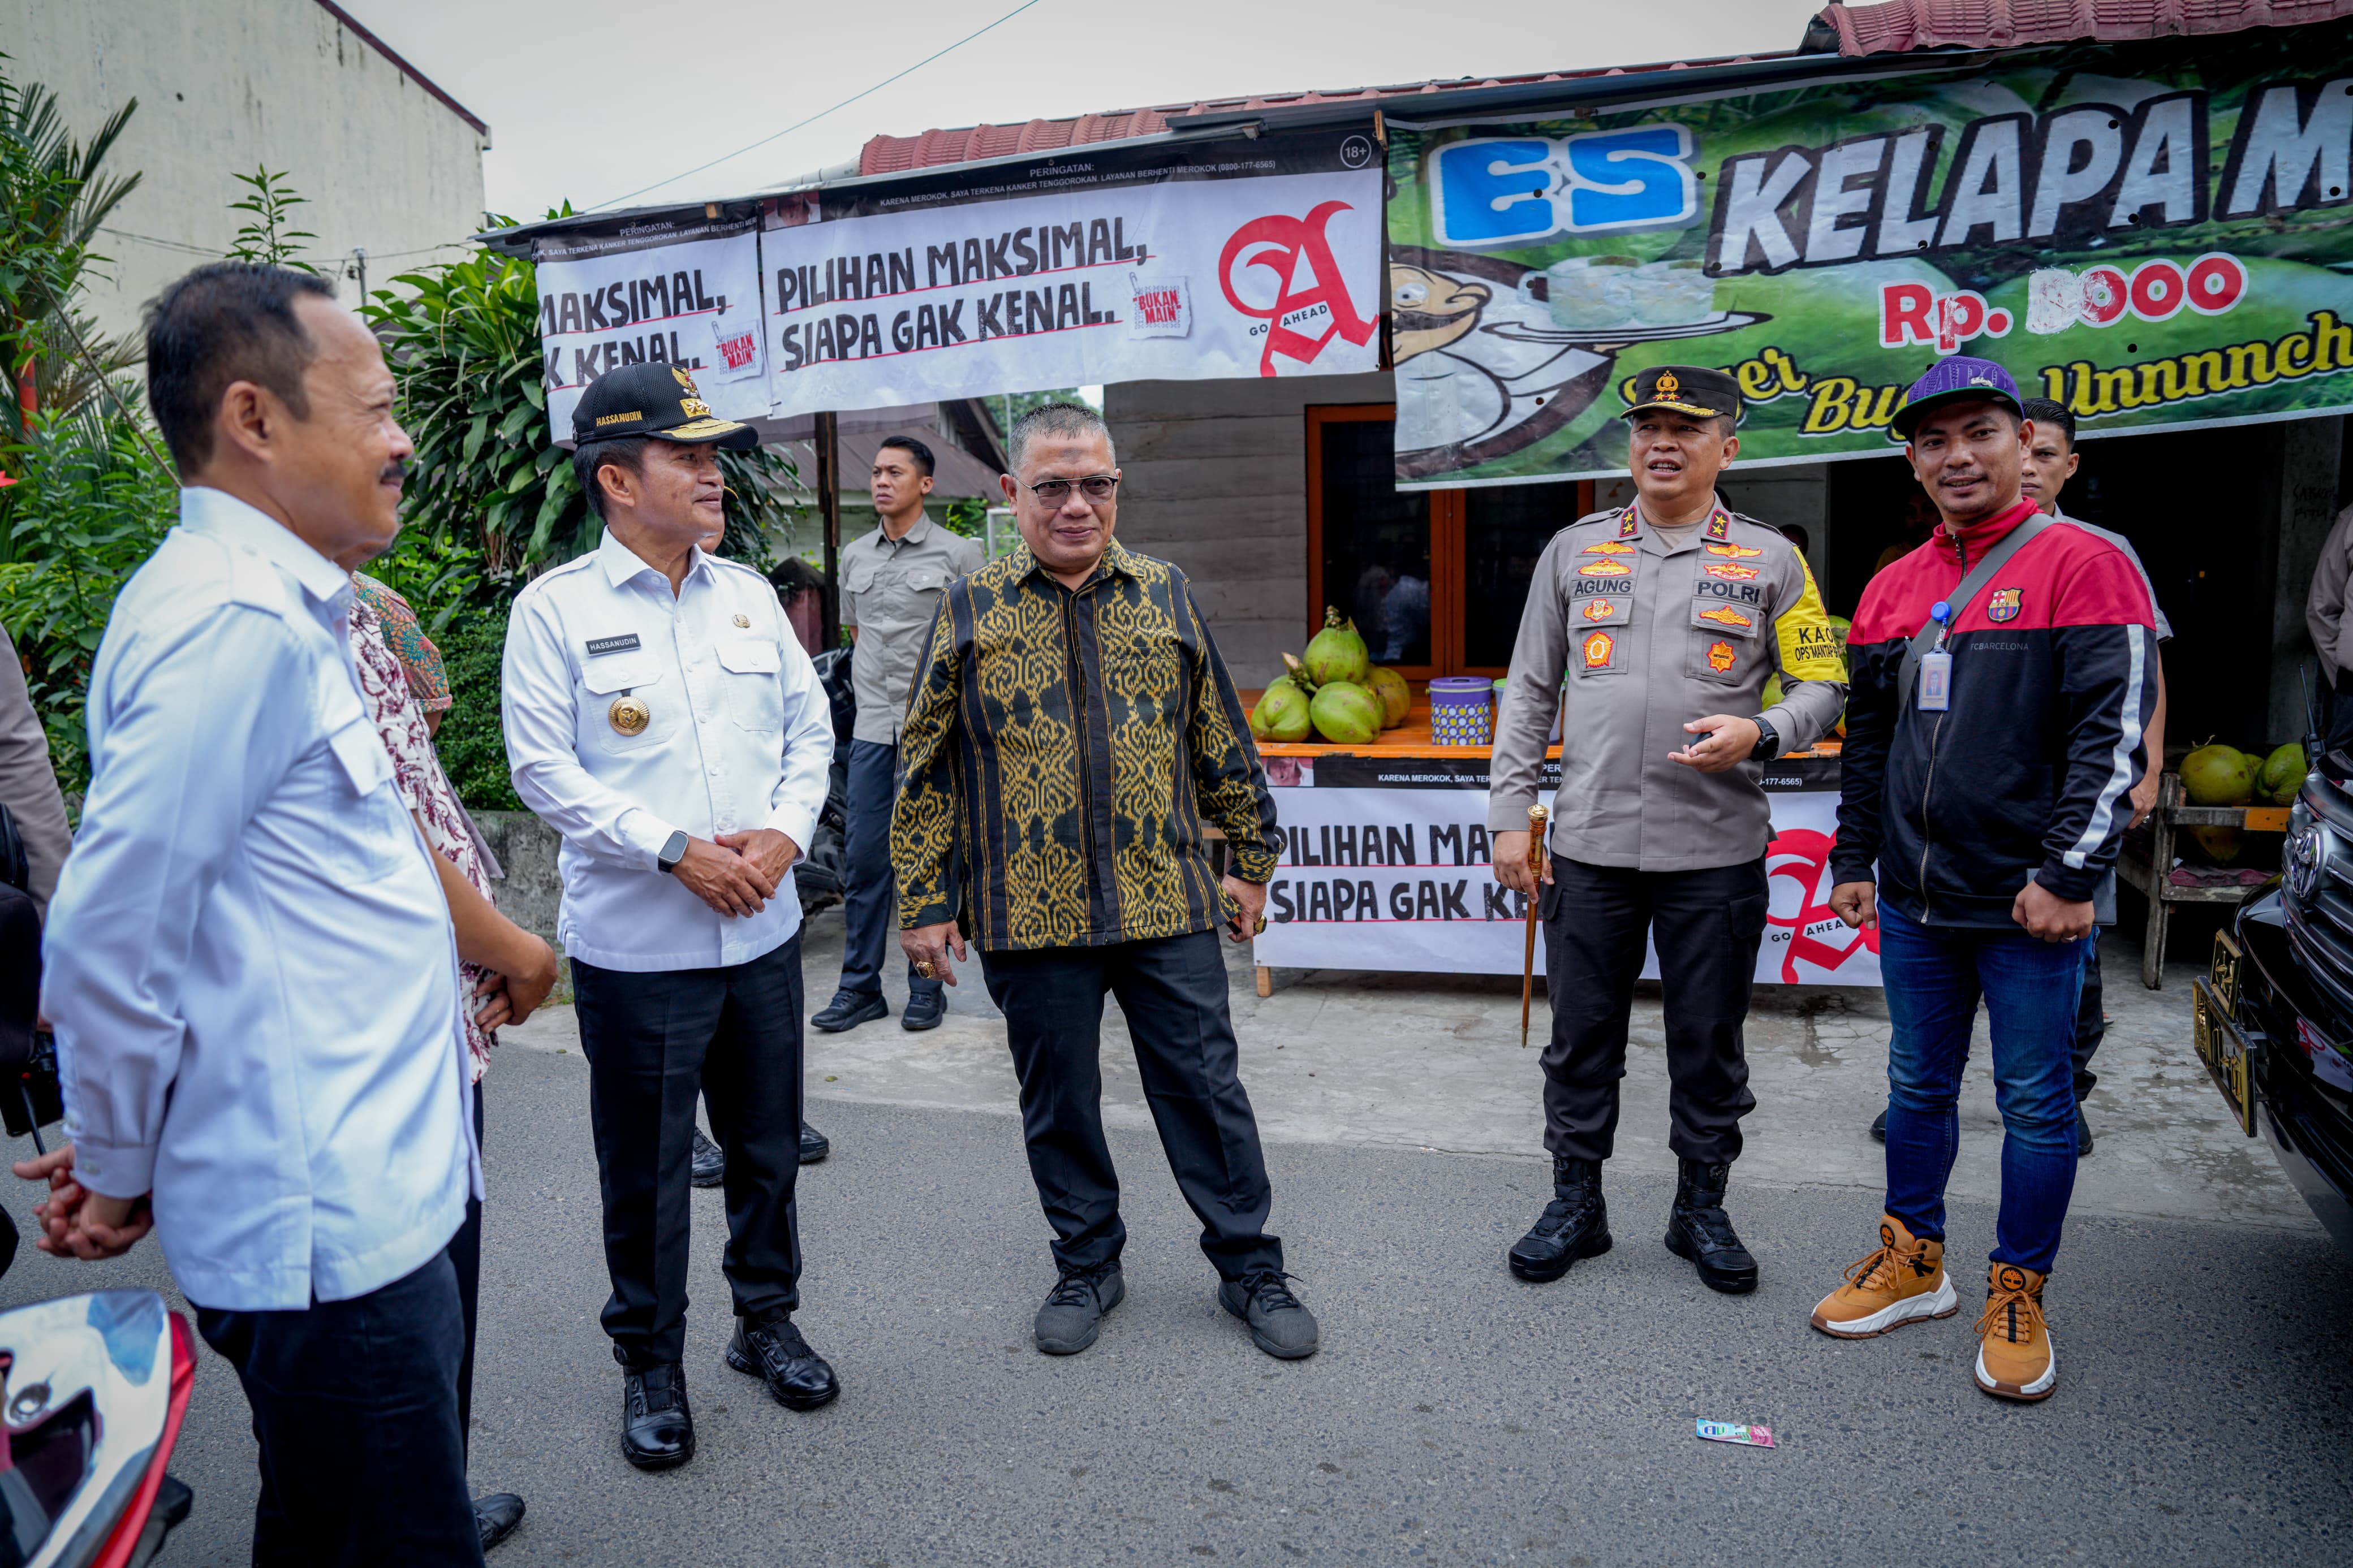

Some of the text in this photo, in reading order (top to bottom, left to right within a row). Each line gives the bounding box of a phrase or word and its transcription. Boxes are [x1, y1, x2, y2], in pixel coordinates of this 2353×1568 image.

[1344, 145, 1367, 158] 18+
[1029, 163, 1094, 178] PERINGATAN:
[880, 196, 910, 207] KARENA
[950, 187, 970, 198] SAYA
[971, 183, 1005, 196] TERKENA
[1006, 181, 1037, 193] KANKER
[1101, 171, 1136, 182] LAYANAN
[1137, 167, 1175, 178] BERHENTI
[1176, 164, 1217, 174] MEROKOK
[1218, 160, 1276, 172] (0800-177-6565)
[1435, 126, 1688, 244] ES
[1720, 97, 2196, 270] KELAPA
[568, 244, 598, 255] TERKENA
[599, 241, 626, 252] KANKER
[680, 226, 710, 237] LAYANAN
[710, 221, 744, 233] BERHENTI
[619, 221, 675, 236] PERINGATAN:
[778, 217, 1147, 315] PILIHAN MAKSIMAL,
[538, 269, 727, 336] MAKSIMAL,
[1884, 257, 2242, 350] Rp. 000
[782, 282, 1115, 372] SIAPA GAK KENAL.
[1249, 304, 1328, 337] GO AHEAD
[596, 410, 643, 427] HASSANUDIN
[1575, 579, 1631, 596] AGUNG
[1698, 581, 1760, 604] POLRI
[590, 637, 637, 651] HASSANUDIN
[1795, 646, 1811, 662] OPS
[1378, 774, 1410, 783] KARENA
[1412, 774, 1453, 784] MEROKOK,
[1270, 878, 1379, 924] SIAPA
[1389, 879, 1472, 921] GAK
[1771, 920, 1847, 942] GO AHEA
